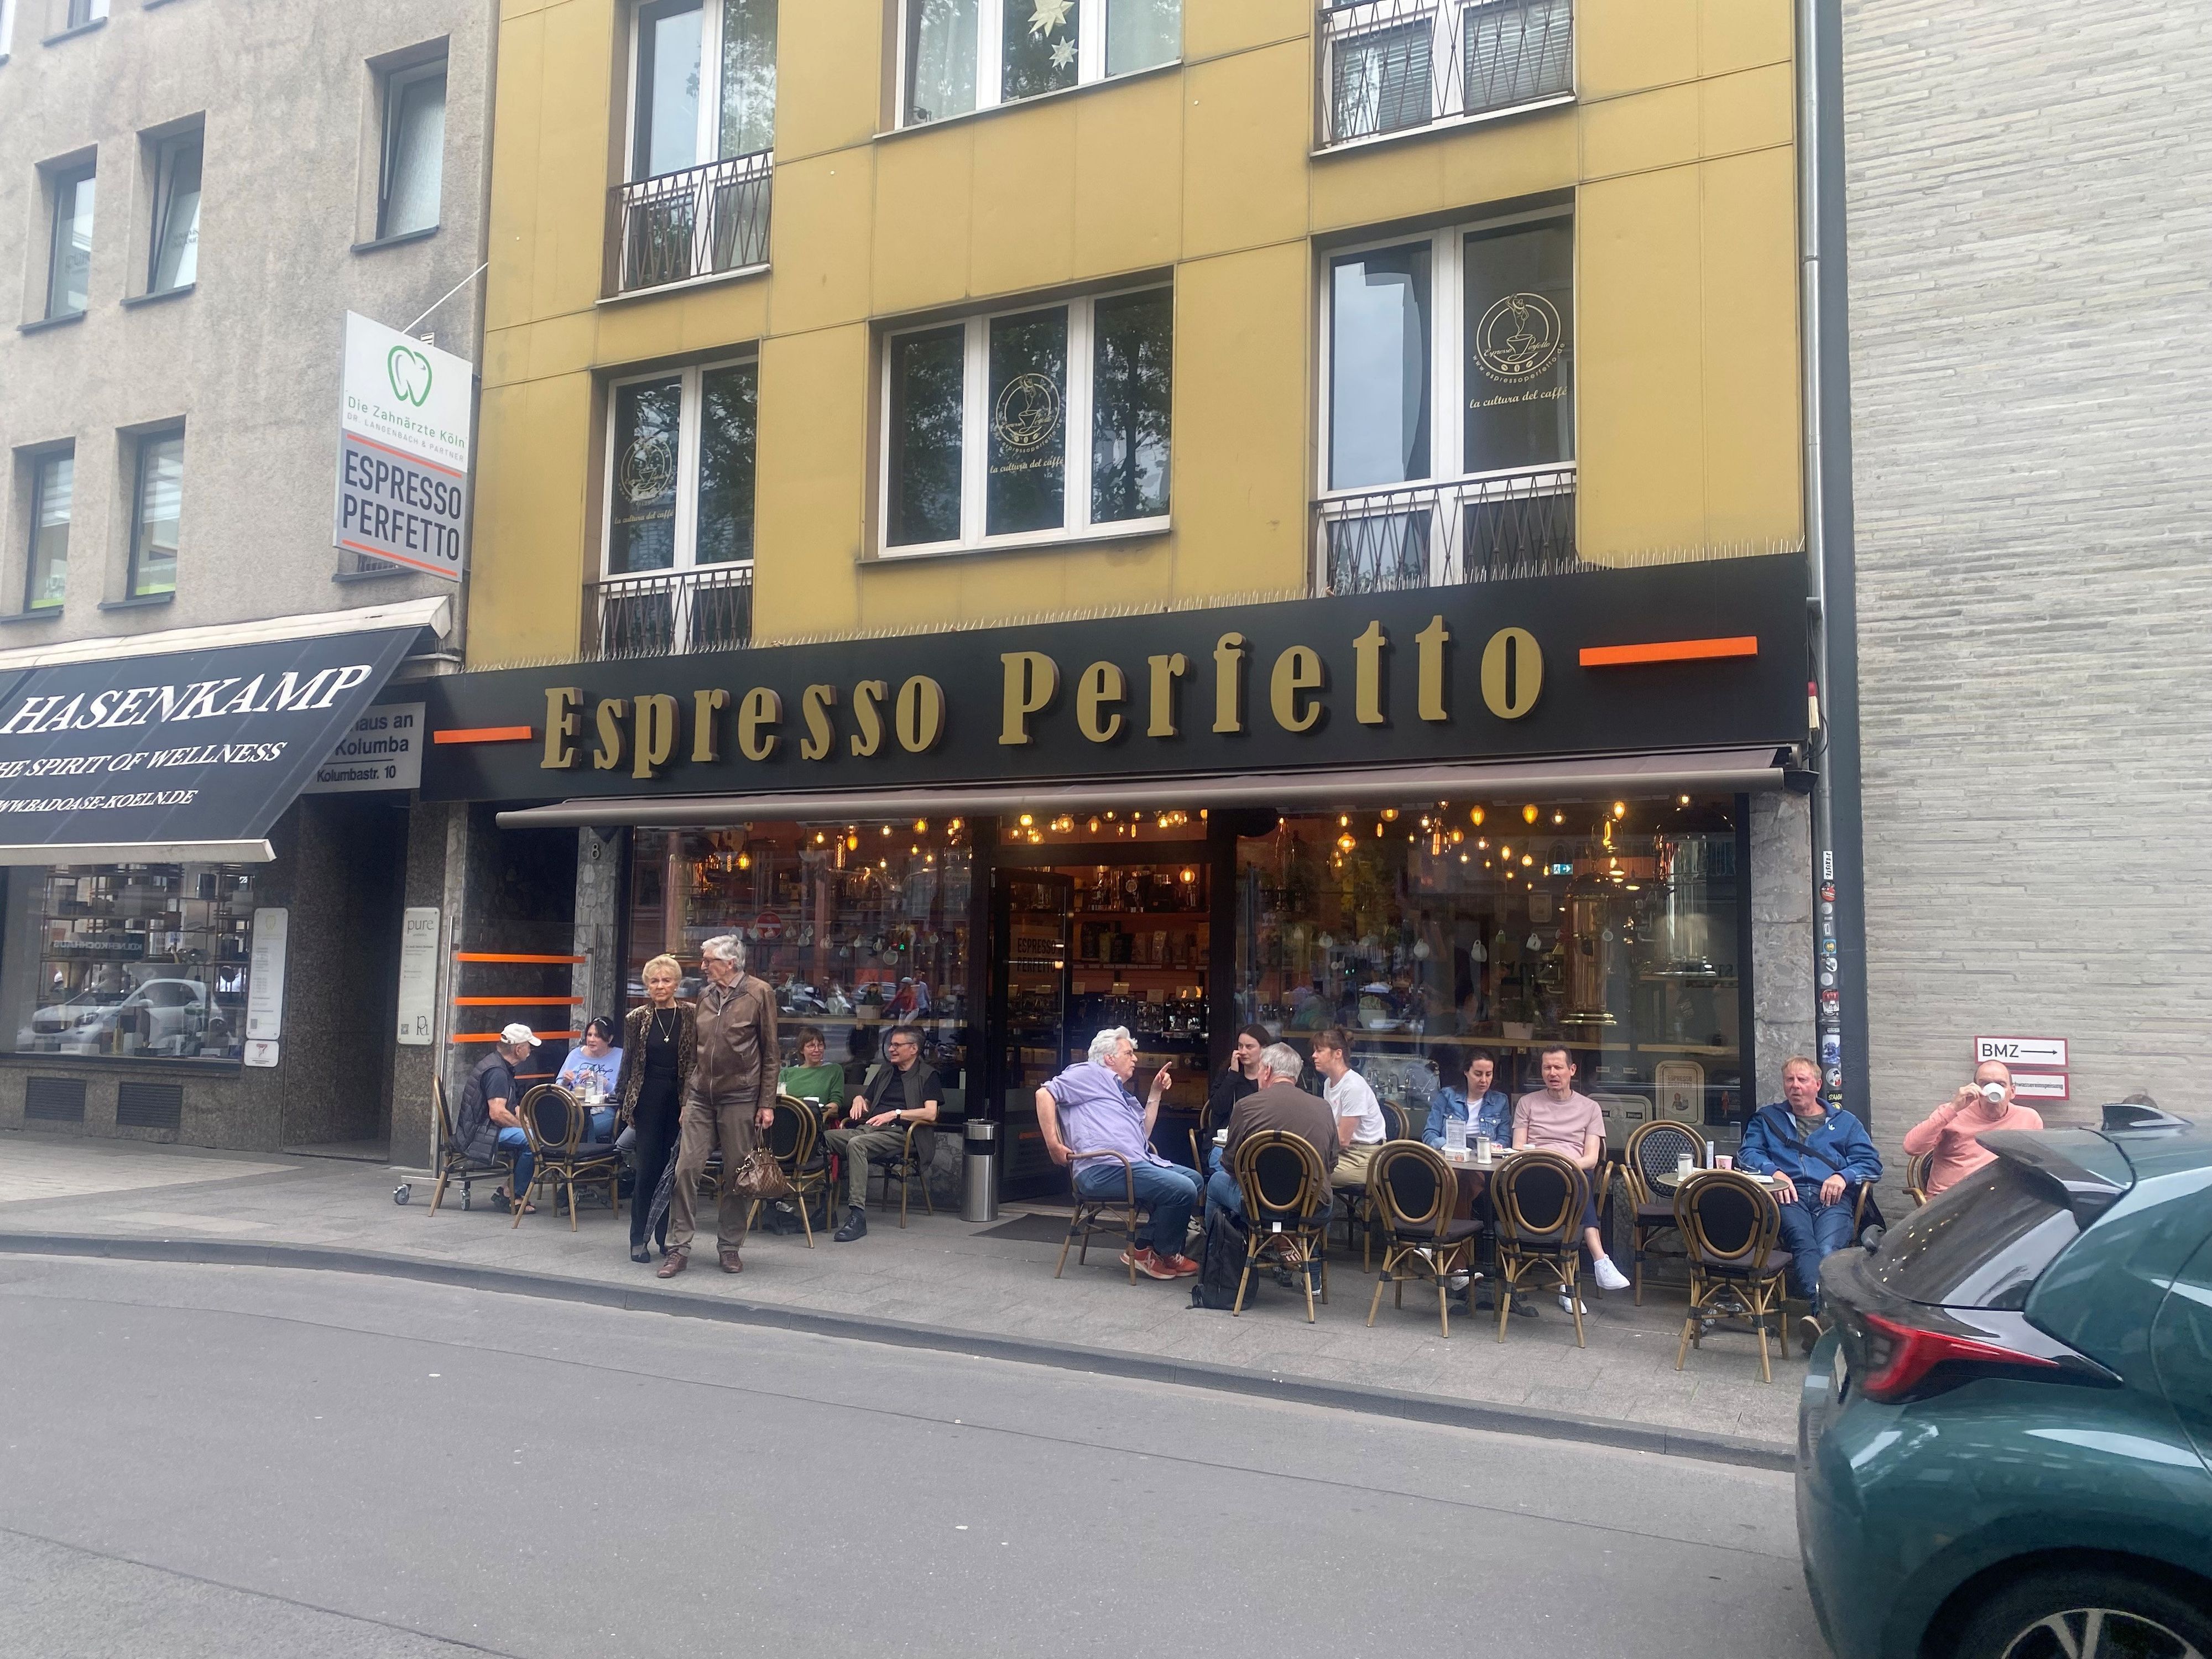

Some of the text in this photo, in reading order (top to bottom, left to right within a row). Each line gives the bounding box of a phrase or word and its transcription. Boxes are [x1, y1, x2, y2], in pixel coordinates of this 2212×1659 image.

[1469, 399, 1481, 409] la
[1483, 395, 1520, 407] cultura
[1522, 389, 1538, 401] del
[348, 396, 465, 448] Die Zahnärzte Köln
[347, 412, 361, 423] DR.
[364, 419, 419, 445] LANGENBACH
[429, 444, 464, 462] PARTNER
[345, 448, 462, 520] ESPRESSO
[342, 493, 460, 561] PERFETTO
[0, 664, 372, 734] HASENKAMP
[540, 614, 1545, 780] Espresso Perfetto
[393, 714, 413, 728] an
[0, 741, 288, 778] HE SPIRIT OF WELLNESS
[335, 736, 409, 756] Kolumba
[317, 765, 396, 782] Kolumbastr. 10
[407, 920, 434, 935] pure
[1018, 937, 1056, 954] ESPRESSO
[1982, 1044, 2019, 1058] BMZ
